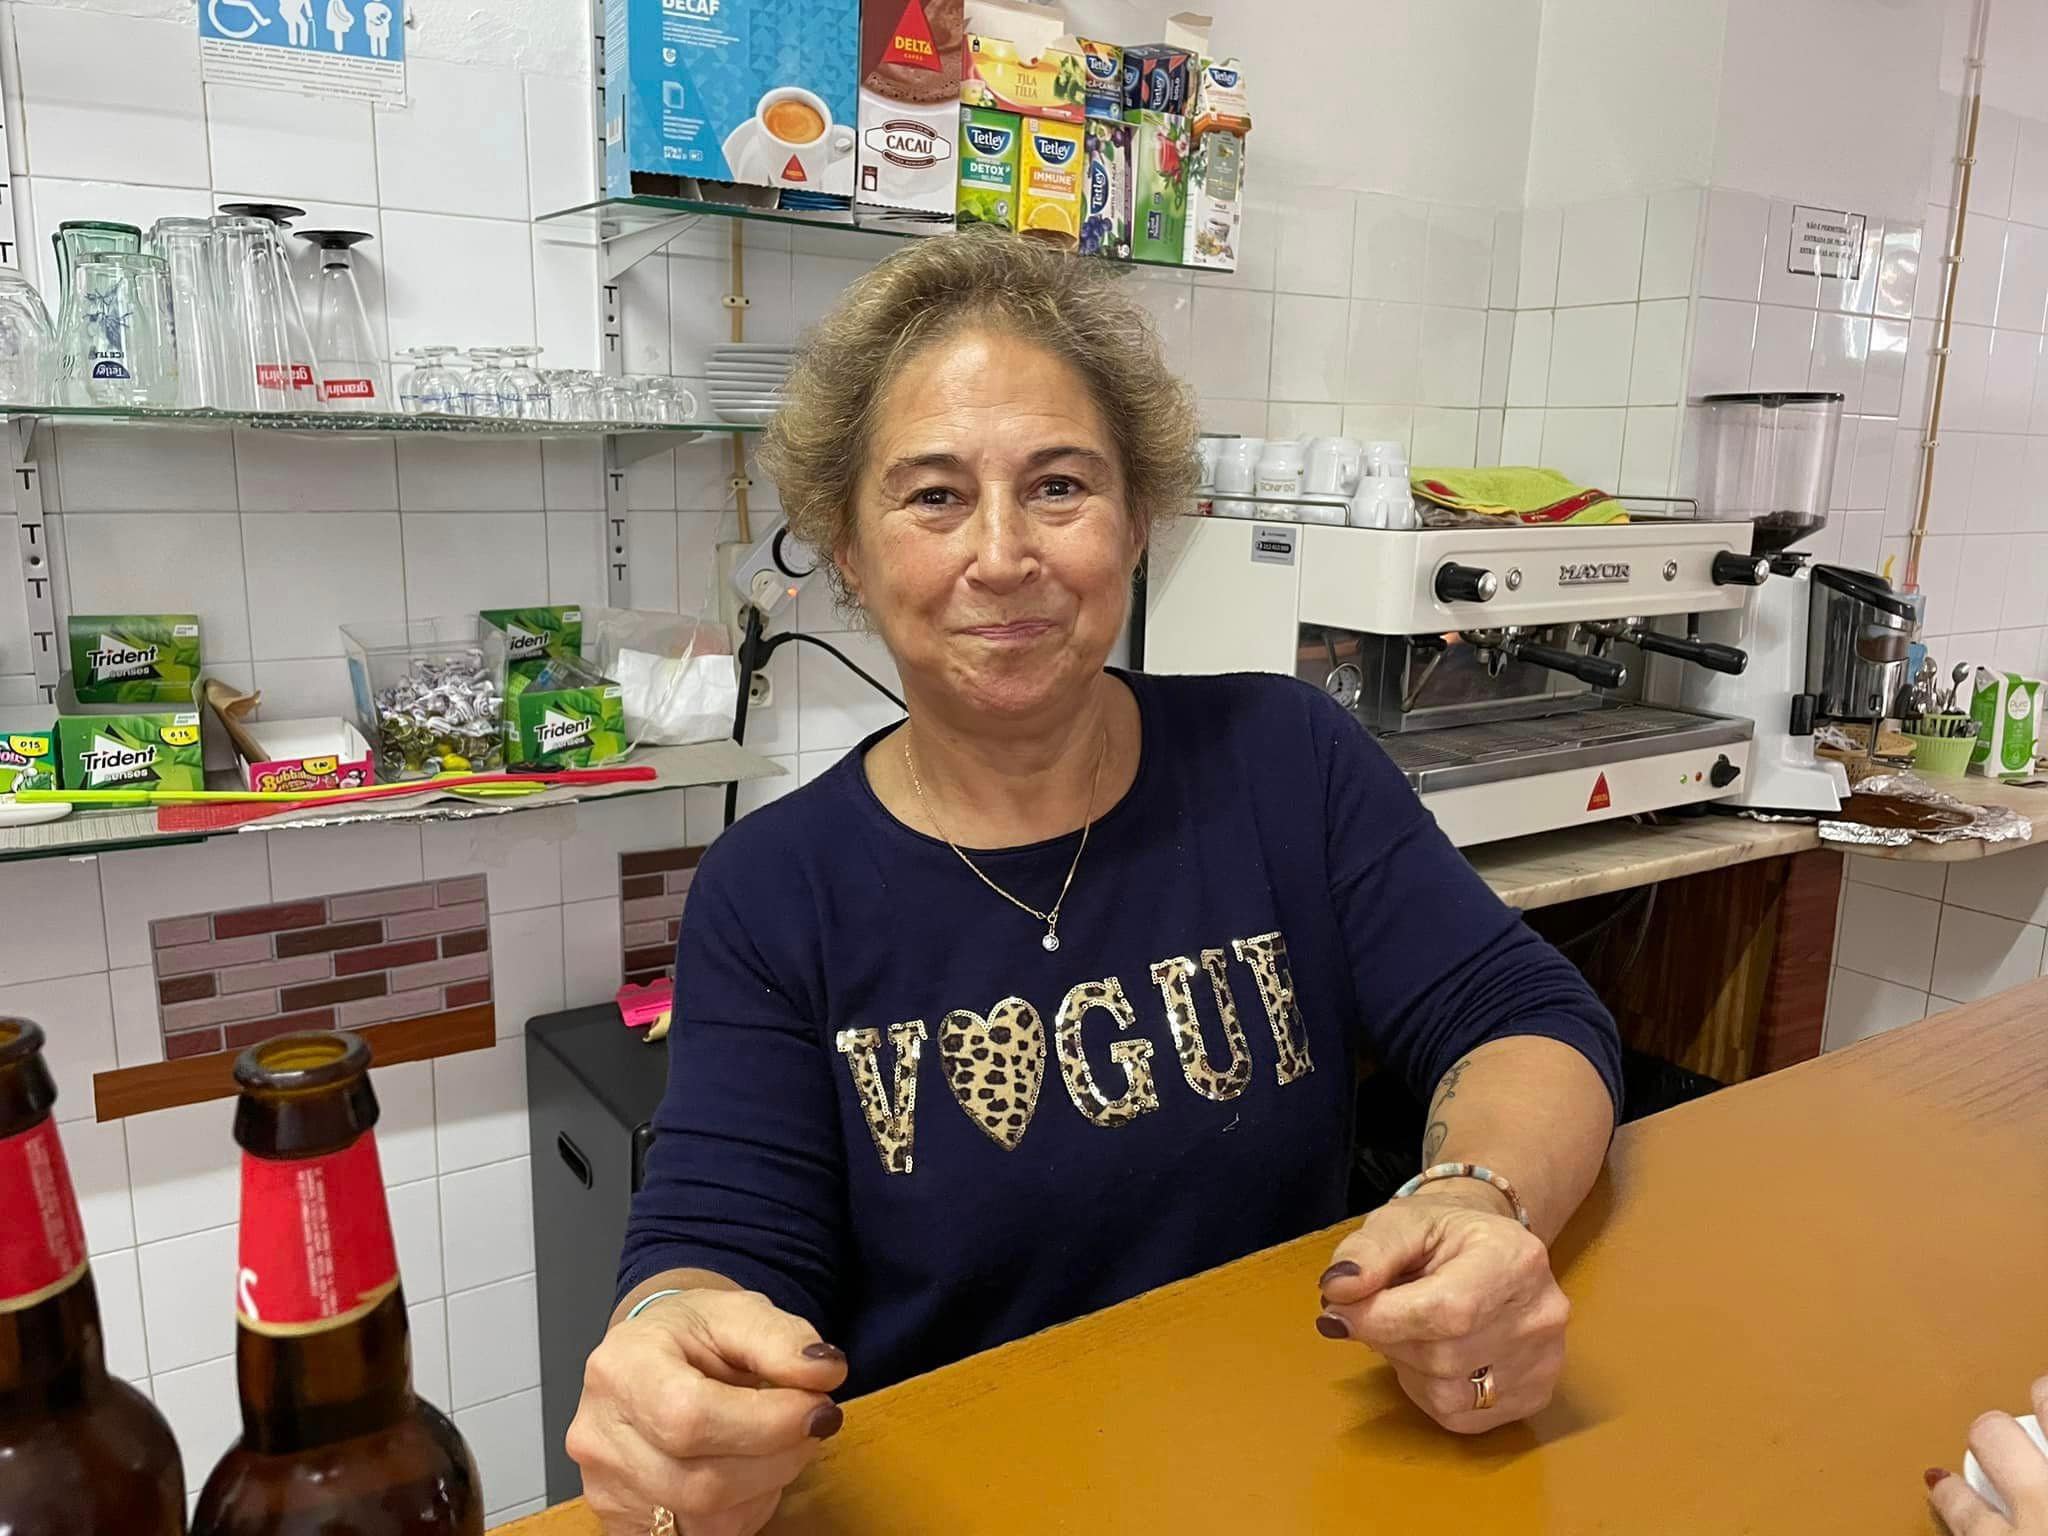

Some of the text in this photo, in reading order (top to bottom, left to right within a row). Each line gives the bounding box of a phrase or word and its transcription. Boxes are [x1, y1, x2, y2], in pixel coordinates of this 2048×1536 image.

[662, 0, 720, 15] DECAF
[895, 35, 933, 55] DELTA
[1213, 69, 1235, 86] Tetley
[1152, 75, 1165, 108] Tetley
[886, 135, 933, 154] CACAU
[971, 130, 1005, 151] Tetley
[1038, 140, 1071, 160] Tetley
[970, 163, 1004, 176] DETOX
[1033, 171, 1072, 185] IMMUNE
[1092, 168, 1106, 209] Tetley
[110, 351, 124, 359] ICE
[95, 364, 124, 377] Tetley
[1559, 563, 1630, 580] MAYOR
[88, 646, 156, 668] Trident
[536, 718, 591, 741] Trident
[81, 746, 155, 770] Trident
